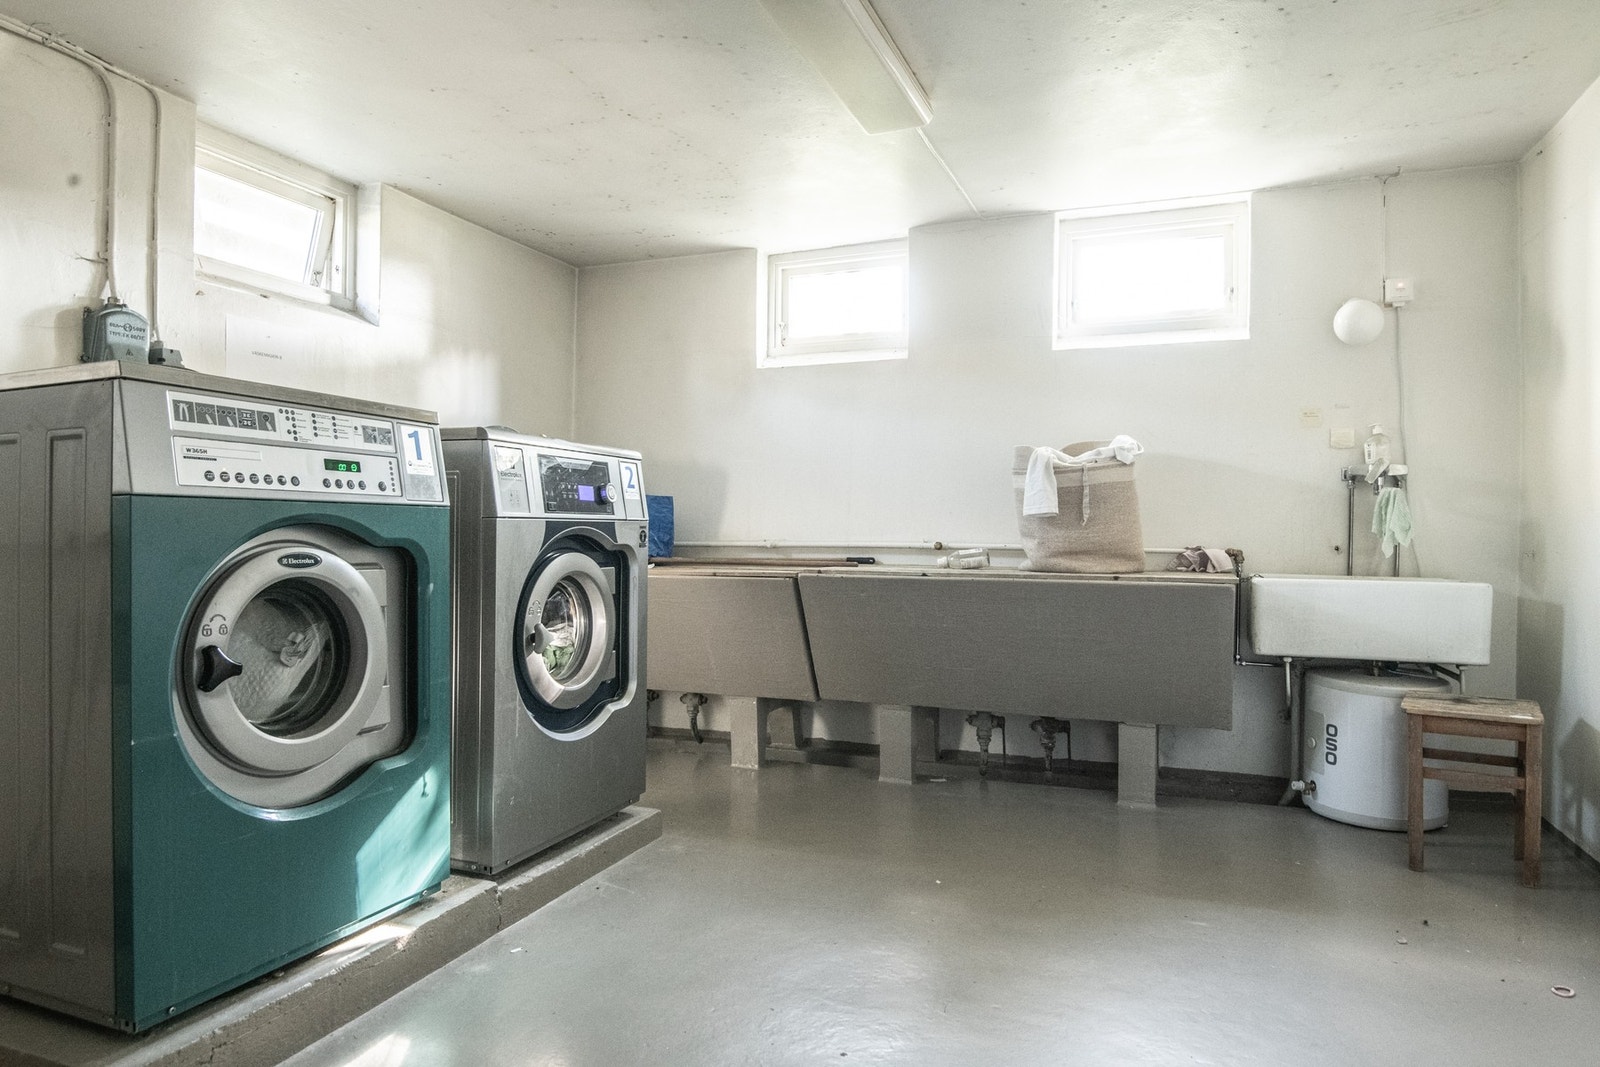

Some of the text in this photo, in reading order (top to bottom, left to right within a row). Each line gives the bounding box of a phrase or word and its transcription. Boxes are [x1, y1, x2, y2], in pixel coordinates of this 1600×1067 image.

[407, 430, 422, 460] 1
[624, 466, 635, 489] 2
[1325, 723, 1338, 766] OSO
